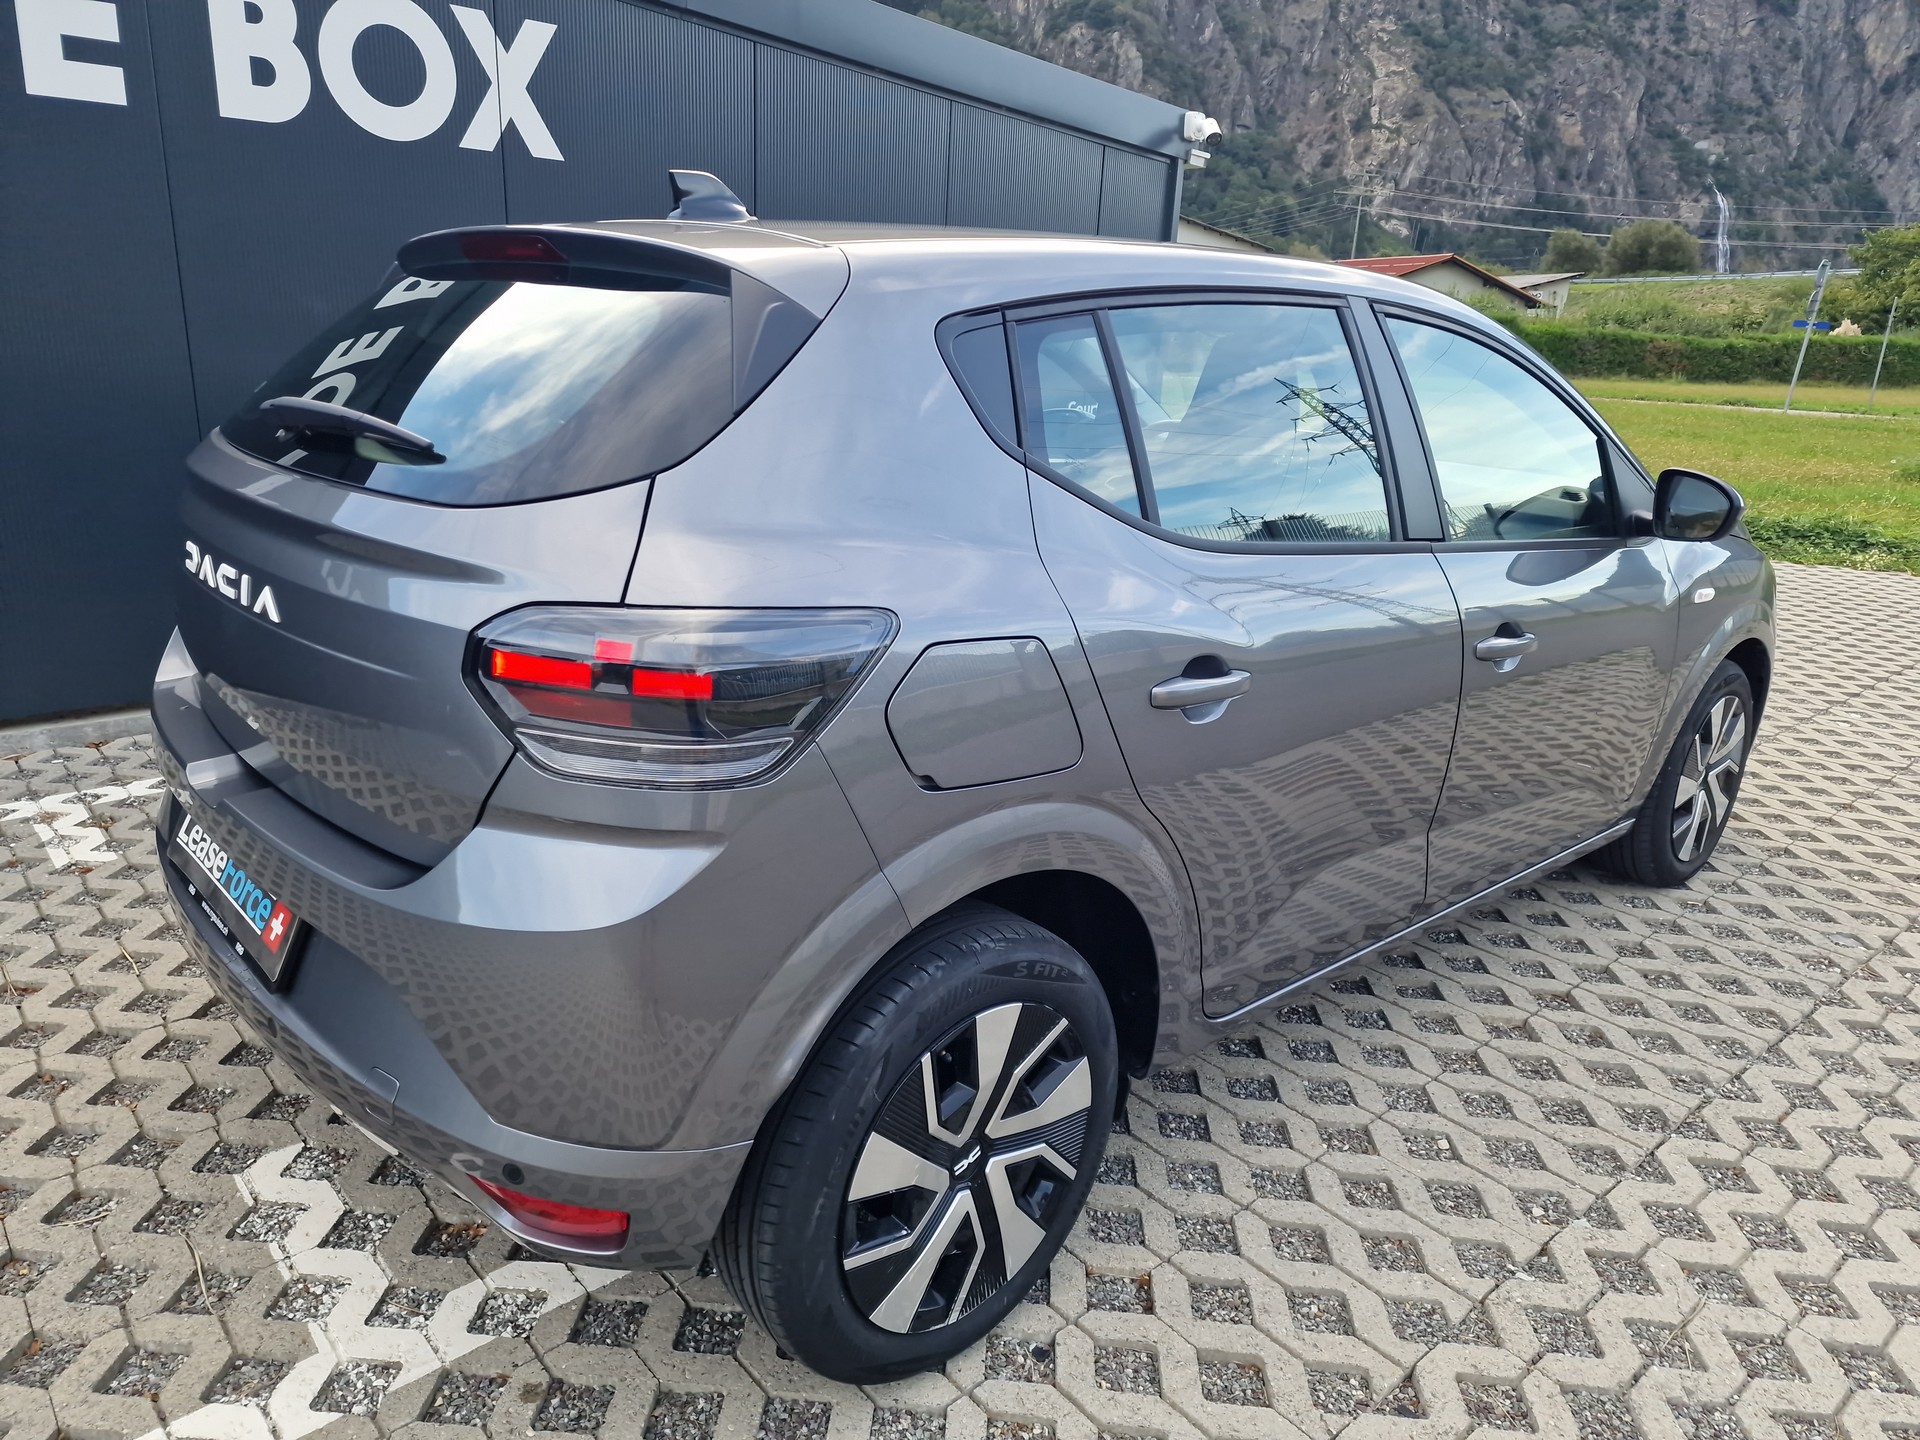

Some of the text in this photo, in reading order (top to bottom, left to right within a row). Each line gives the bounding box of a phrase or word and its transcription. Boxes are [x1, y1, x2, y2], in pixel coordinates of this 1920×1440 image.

[15, 0, 565, 162] E BOX
[185, 540, 282, 624] DACIA
